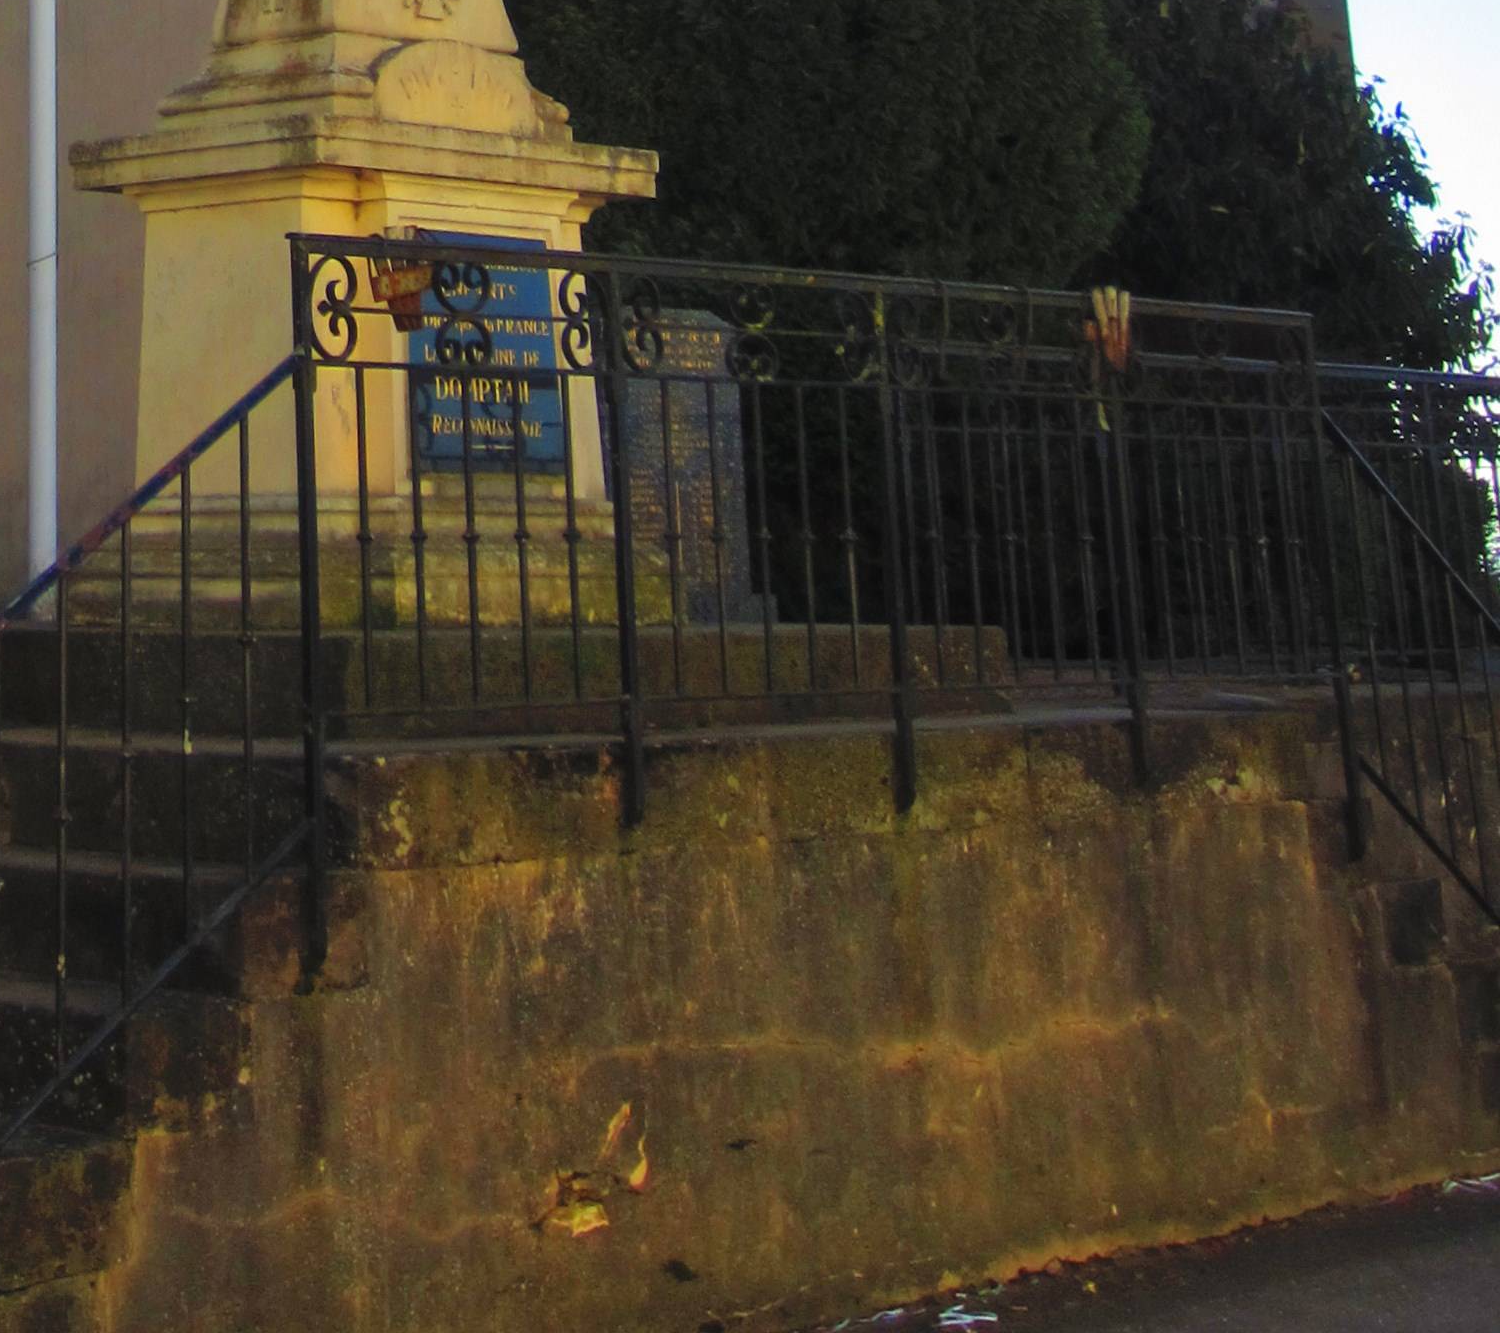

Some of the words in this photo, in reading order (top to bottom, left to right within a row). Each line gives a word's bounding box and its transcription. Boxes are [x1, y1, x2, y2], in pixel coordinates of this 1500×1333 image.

[497, 318, 549, 336] FRANCE
[443, 346, 516, 366] CMMUNE
[432, 413, 543, 438] RECONNAISSNTE
